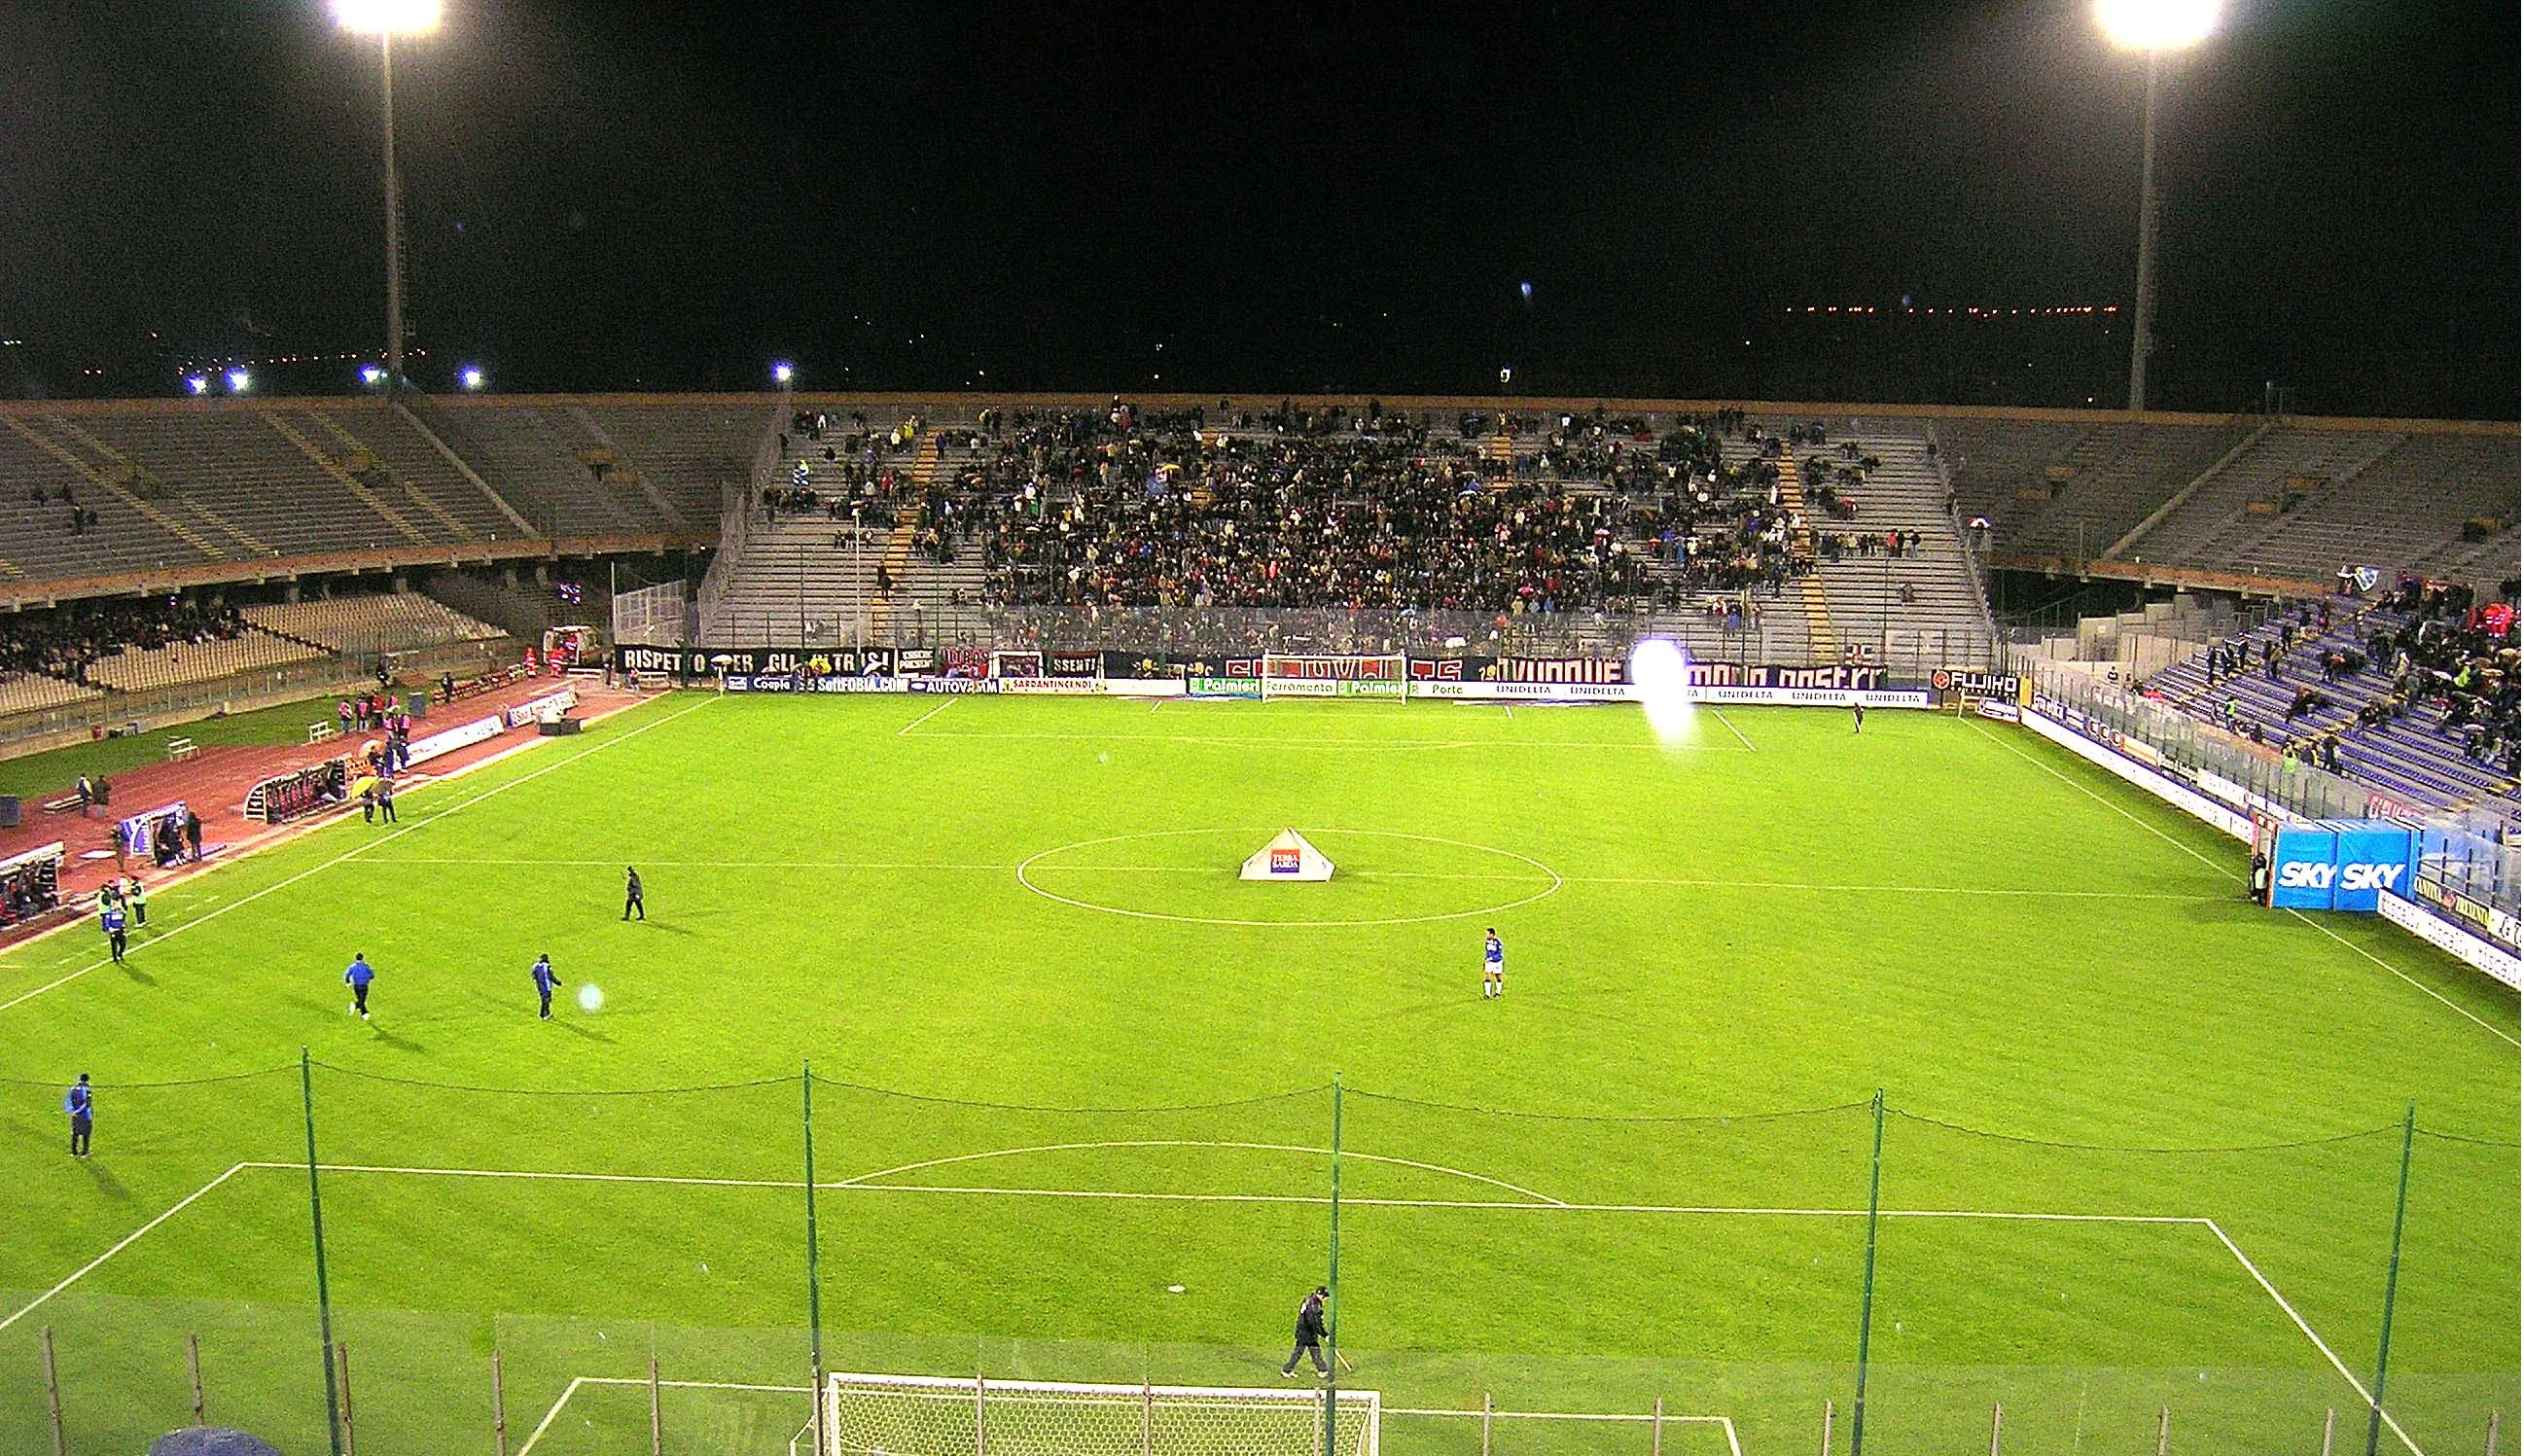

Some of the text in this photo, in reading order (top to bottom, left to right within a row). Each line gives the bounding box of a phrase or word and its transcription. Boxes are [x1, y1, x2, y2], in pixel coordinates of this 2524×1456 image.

[624, 650, 705, 672] RISPETO
[2277, 861, 2336, 889] SKY
[2339, 863, 2405, 891] SKY
